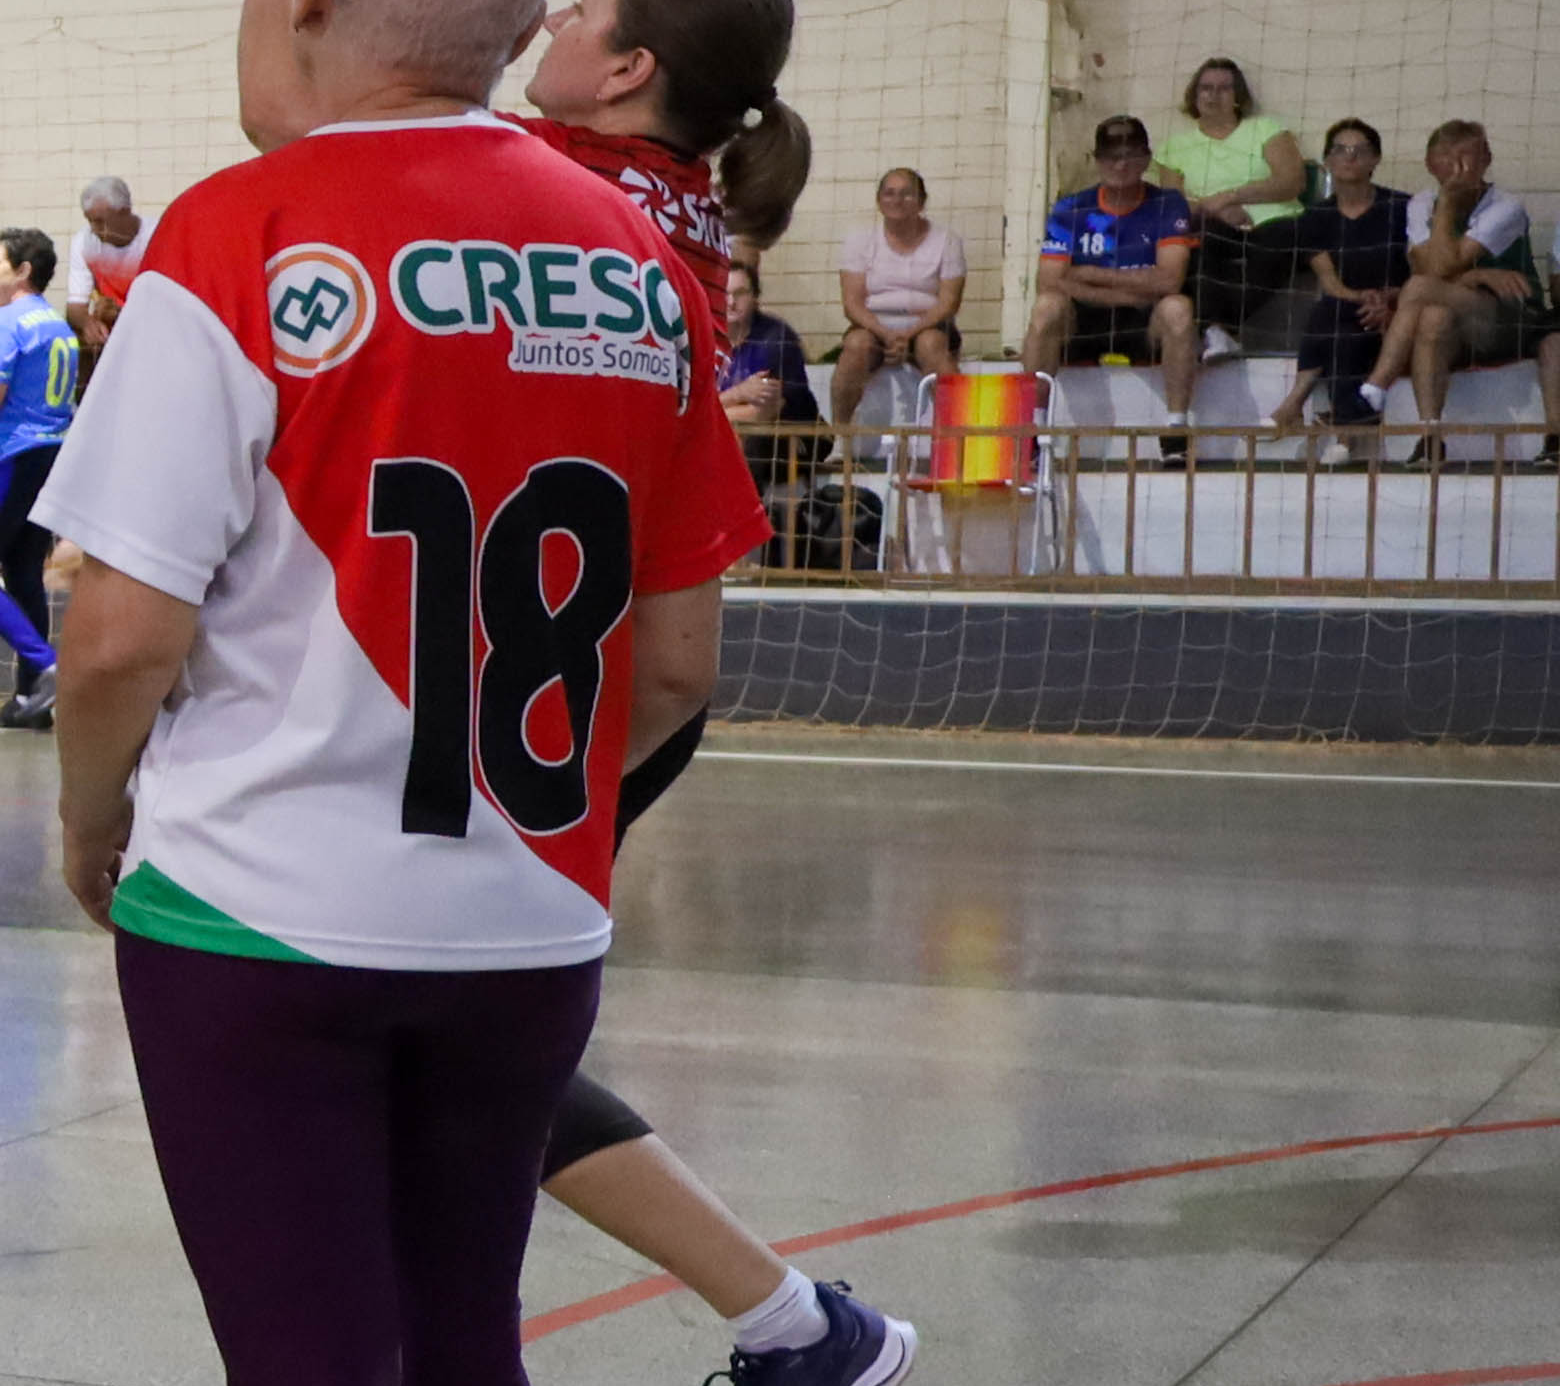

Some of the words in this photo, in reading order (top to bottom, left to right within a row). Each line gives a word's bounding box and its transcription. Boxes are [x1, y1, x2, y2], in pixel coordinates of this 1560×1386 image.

[1079, 223, 1105, 255] 18
[514, 339, 594, 367] Juntos
[602, 343, 671, 377] Somos
[367, 457, 633, 838] 18
